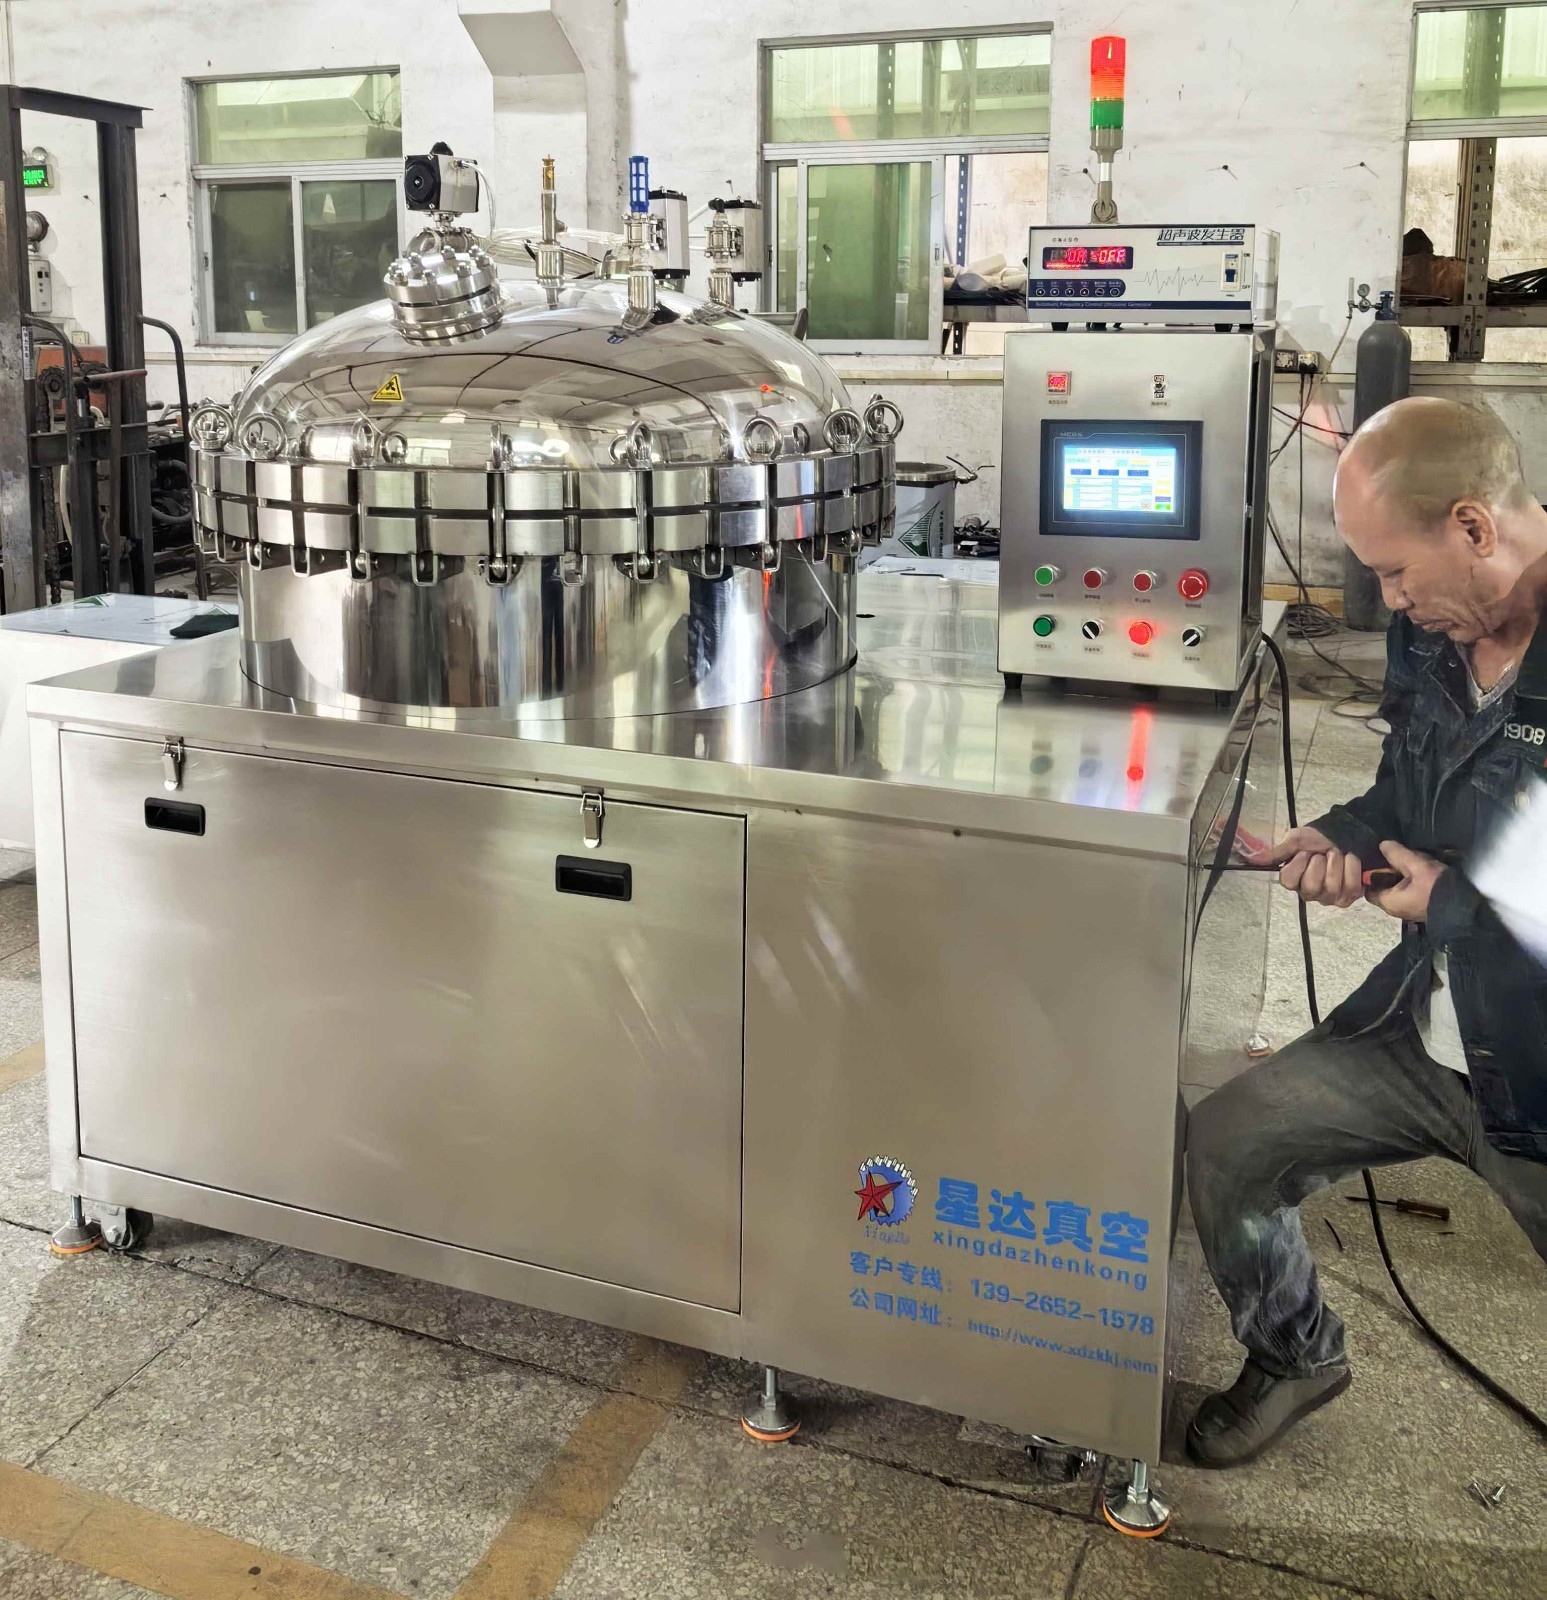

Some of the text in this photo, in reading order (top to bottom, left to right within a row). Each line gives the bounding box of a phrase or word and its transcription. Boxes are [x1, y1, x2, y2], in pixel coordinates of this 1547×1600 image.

[1157, 228, 1246, 241] 超声波发生器
[1503, 722, 1546, 746] 1908
[934, 1176, 1150, 1264] 星达真空
[932, 1230, 1148, 1292] xingdazhenkong
[970, 1278, 1156, 1336] 139-2652-1578
